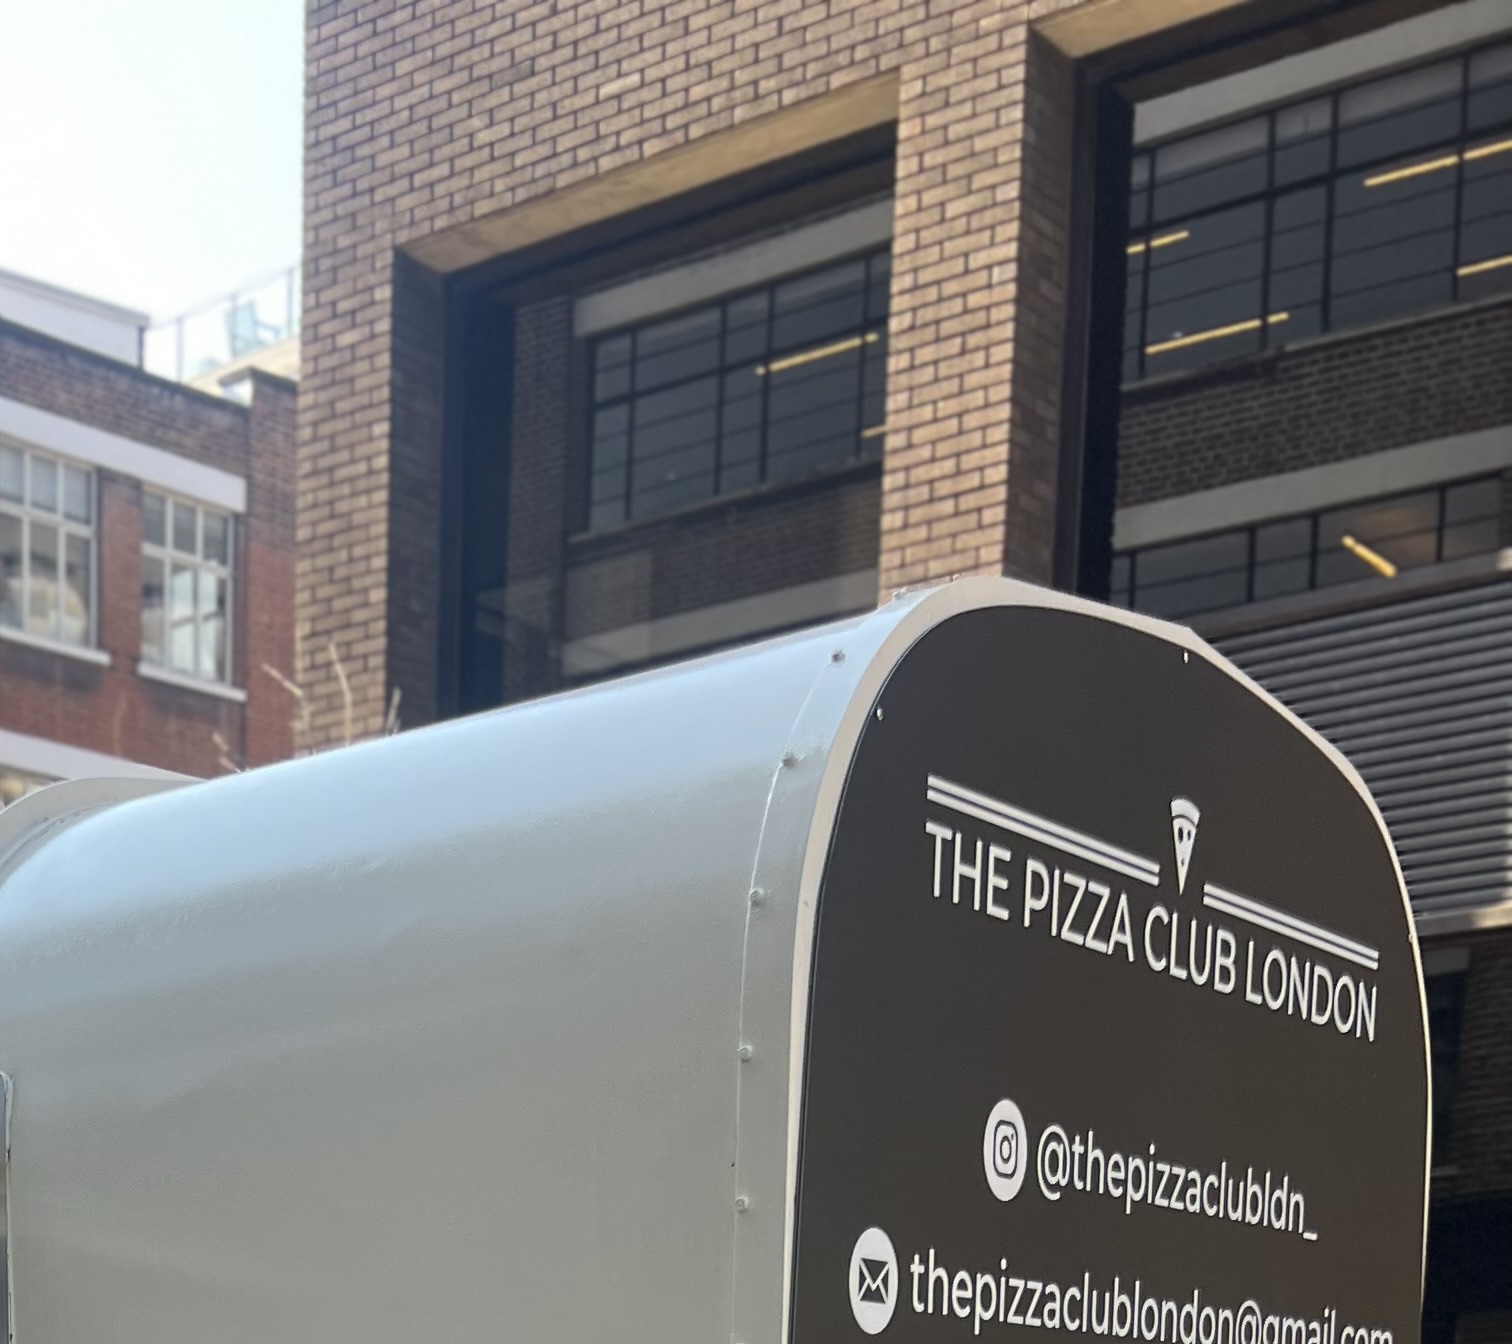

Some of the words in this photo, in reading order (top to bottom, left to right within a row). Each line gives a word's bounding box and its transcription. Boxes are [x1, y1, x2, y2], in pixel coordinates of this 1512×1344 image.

[925, 819, 1009, 921] THE
[1024, 857, 1135, 963] PIZZA
[1144, 904, 1237, 995] CLUB
[1245, 938, 1377, 1042] LONDON
[1037, 1123, 1318, 1241] @thepizzaclubldn_
